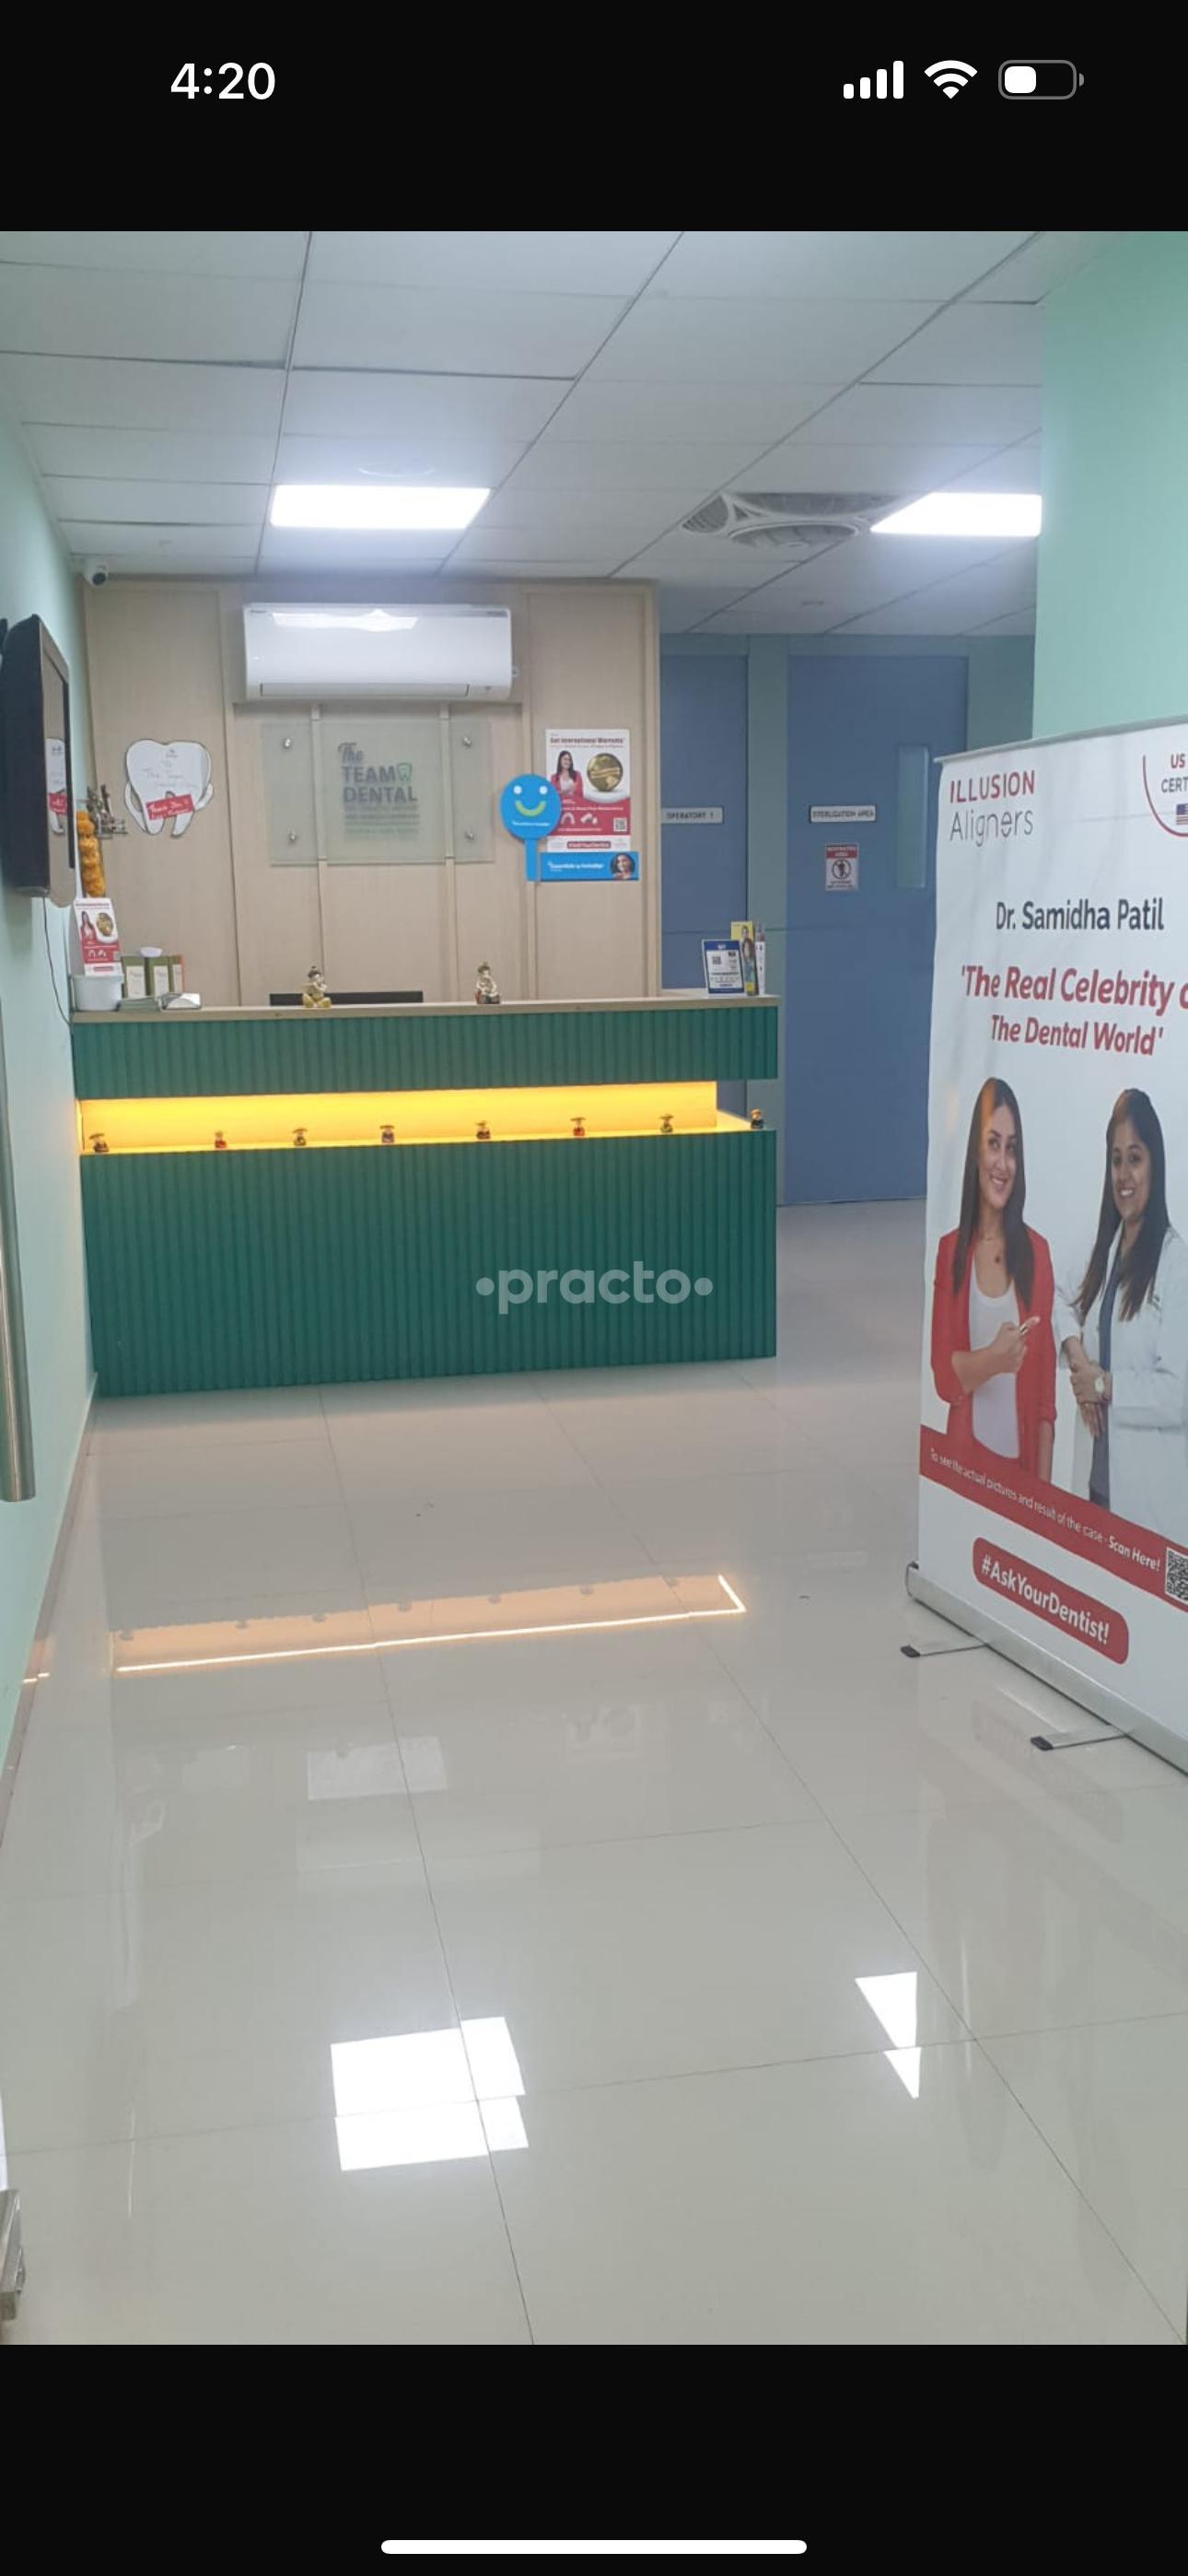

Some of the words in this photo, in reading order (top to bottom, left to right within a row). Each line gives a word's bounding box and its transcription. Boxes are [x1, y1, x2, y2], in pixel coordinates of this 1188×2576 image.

[337, 742, 364, 763] The
[1170, 753, 1186, 768] US
[342, 766, 396, 783] TEAM
[949, 769, 1035, 803] ILLUSION
[343, 787, 418, 803] DENTAL
[949, 808, 1034, 848] Aligners
[996, 902, 1017, 930] Dr.
[1022, 899, 1111, 930] Samidha
[1117, 897, 1164, 931] Patil
[961, 965, 1001, 998] 'The
[1005, 966, 1056, 1001] Real
[1060, 968, 1175, 1016] Celebrity
[991, 1014, 1021, 1042] The
[1024, 1017, 1088, 1048] Dental
[1093, 1022, 1164, 1056] World'
[963, 1469, 986, 1486] actual
[986, 1478, 1018, 1501] pictures
[1034, 1501, 1056, 1521] result
[1066, 1516, 1081, 1532] the
[1082, 1526, 1103, 1543] case
[1108, 1535, 1131, 1559] Scan
[1131, 1548, 1160, 1572] Here!
[981, 1554, 1111, 1645] #AskYourDentist!
